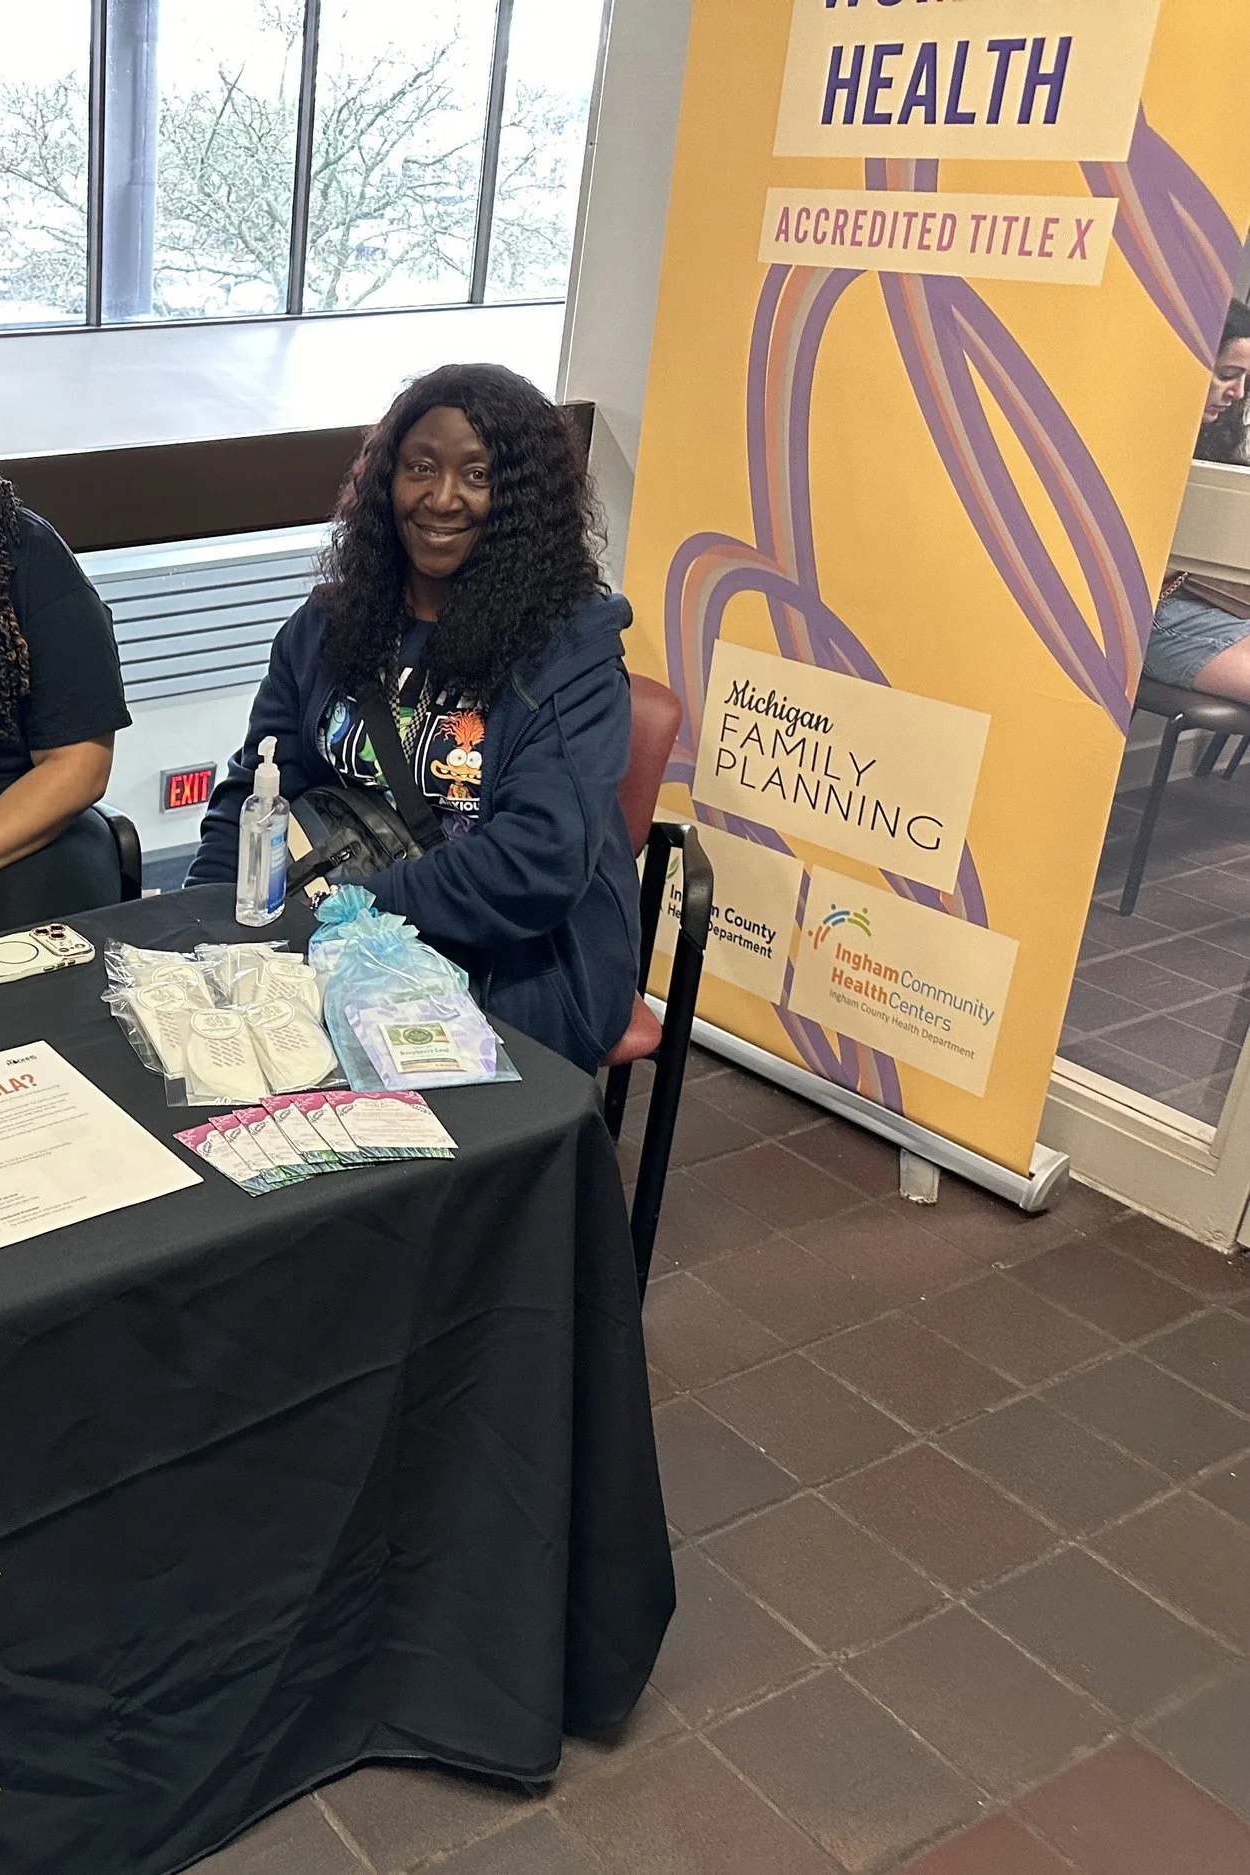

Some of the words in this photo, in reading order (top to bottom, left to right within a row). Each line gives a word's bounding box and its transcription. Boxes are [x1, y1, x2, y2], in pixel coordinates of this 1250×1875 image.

[821, 36, 1073, 125] HEALTH
[774, 206, 957, 252] ACCREDITED
[968, 213, 1060, 259] TITLE
[1067, 218, 1094, 260] X
[724, 679, 834, 737] Michigan
[720, 712, 877, 788] FAMILY
[170, 770, 212, 808] EXIT
[715, 747, 944, 851] PLANNING
[724, 907, 777, 944] County
[829, 989, 859, 1009] Ingham
[860, 1002, 890, 1023] County
[891, 1016, 920, 1036] Health
[921, 1028, 975, 1060] Department
